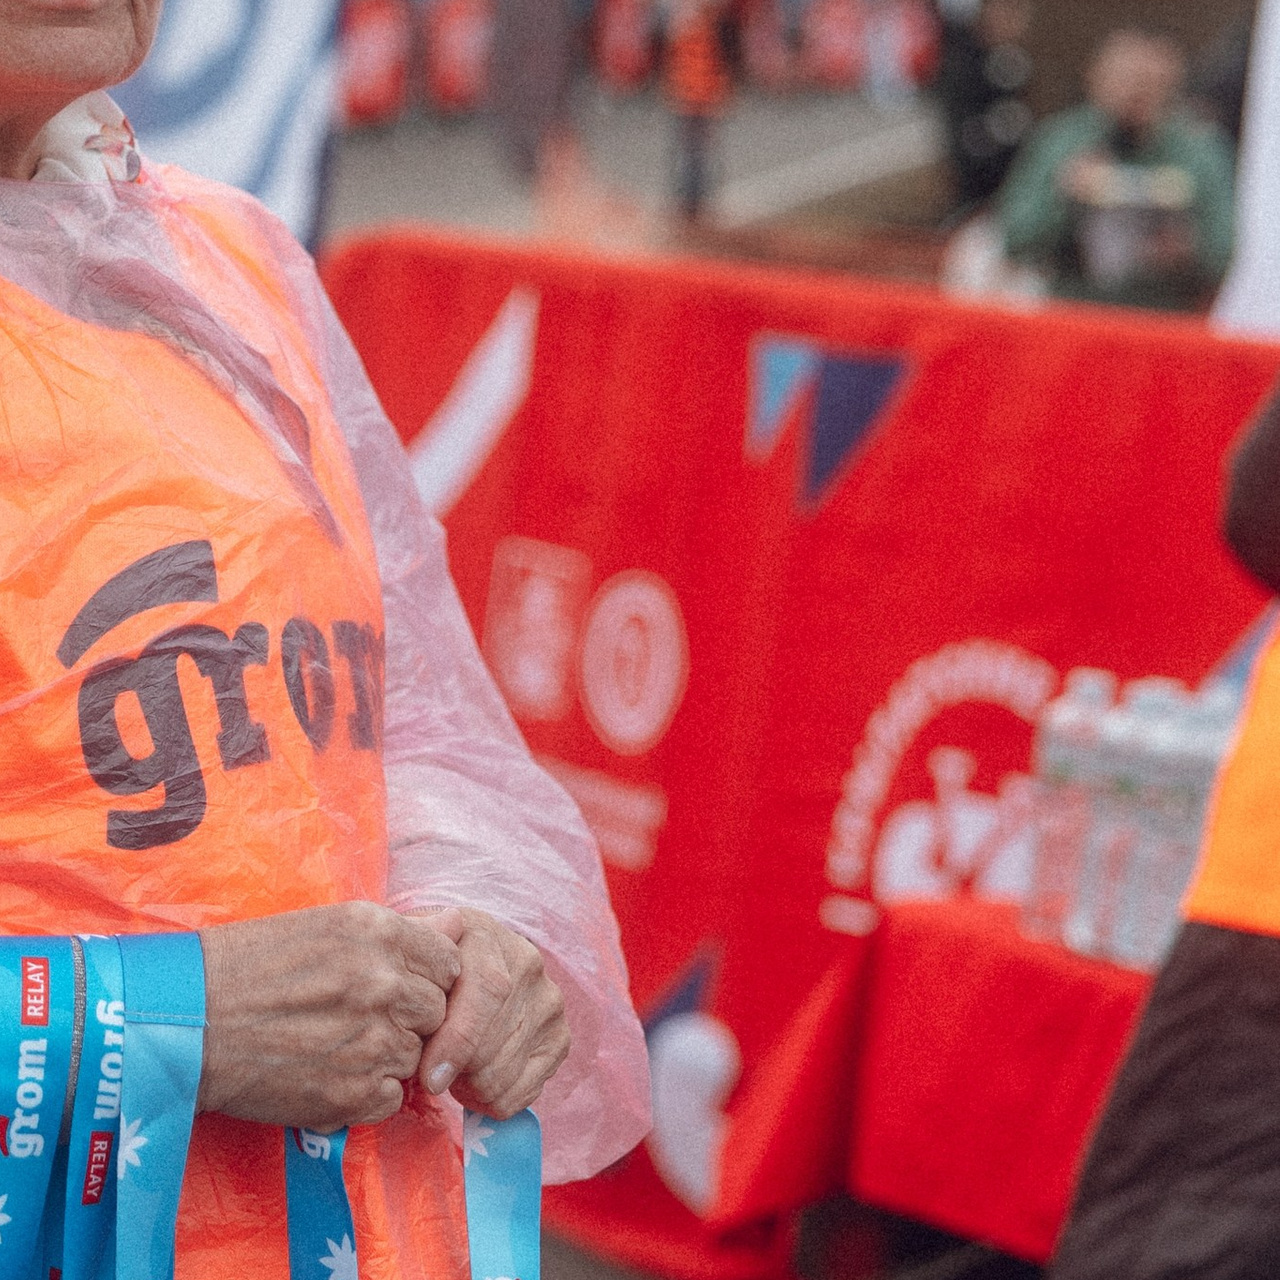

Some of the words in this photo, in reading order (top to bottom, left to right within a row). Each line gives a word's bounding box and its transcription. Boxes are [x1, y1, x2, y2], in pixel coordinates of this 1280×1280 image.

[27, 961, 45, 1018] RELAY
[9, 1038, 48, 1158] grom
[85, 1140, 108, 1198] RELAY
